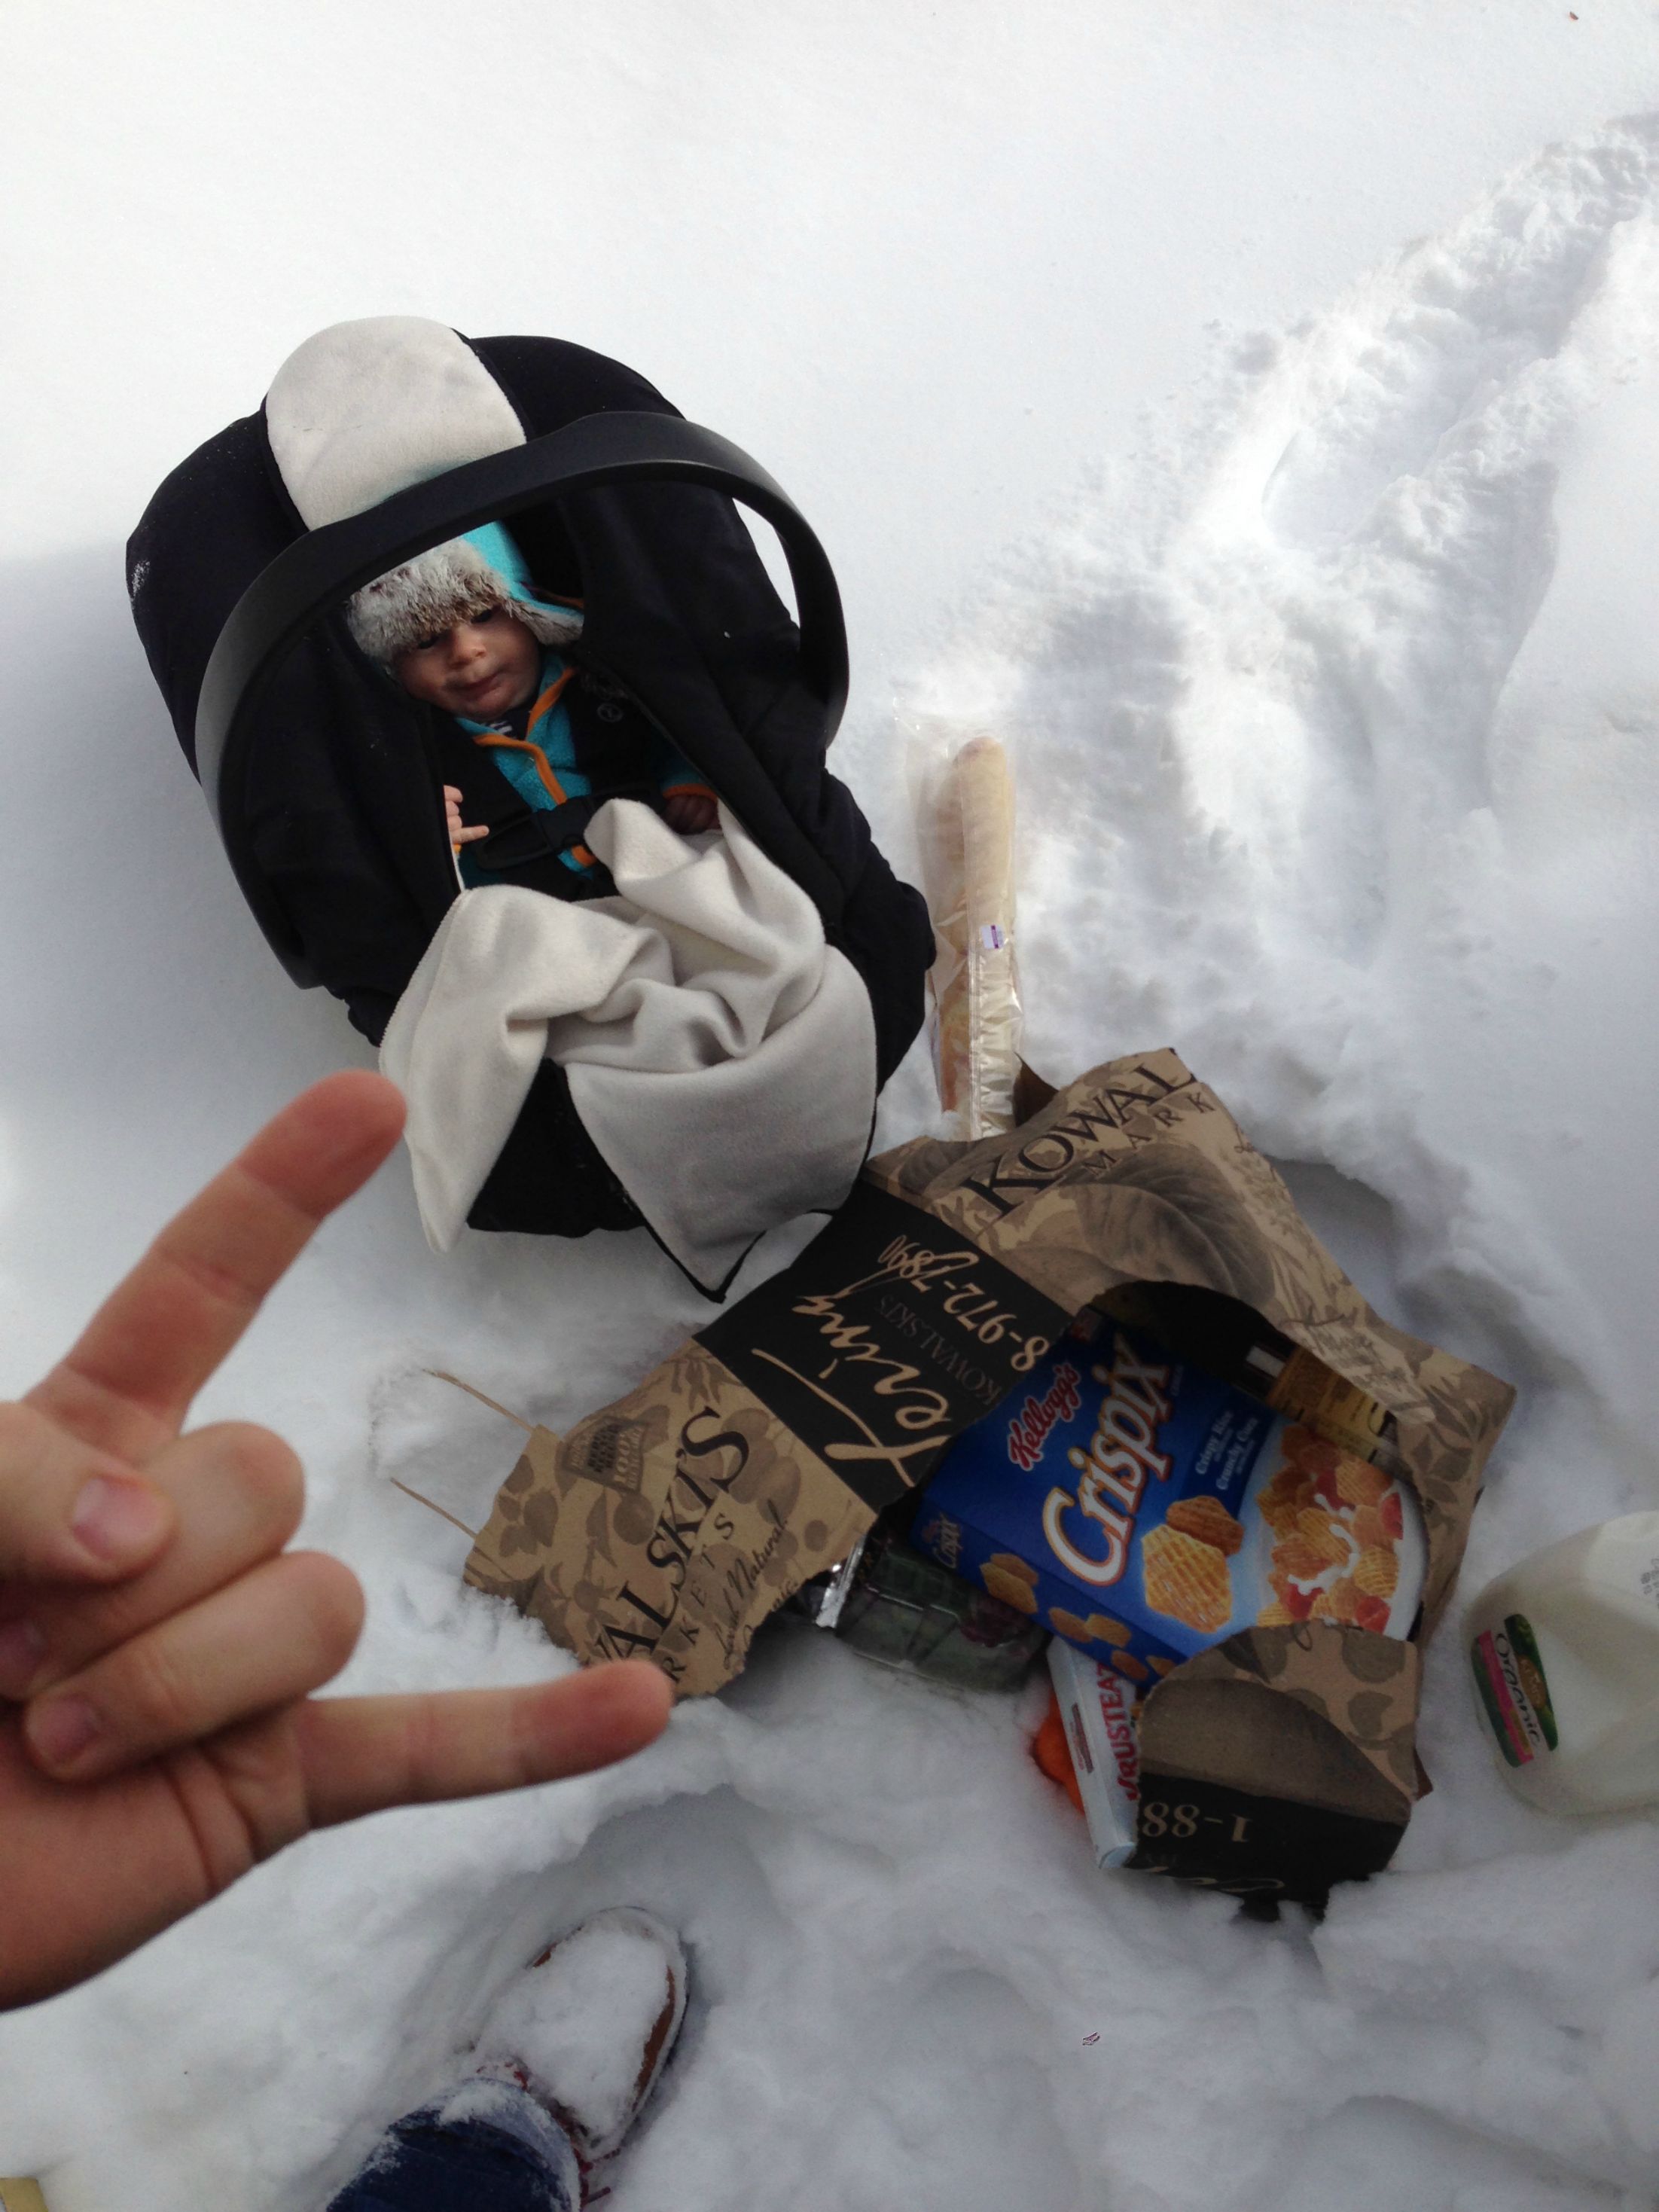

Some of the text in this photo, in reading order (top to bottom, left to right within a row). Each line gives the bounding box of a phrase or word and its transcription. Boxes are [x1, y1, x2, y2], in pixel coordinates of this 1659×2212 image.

[960, 1066, 1197, 1217] KOWAL
[1083, 1094, 1215, 1177] MARK
[1008, 1362, 1081, 1472] Kellogg's
[1042, 1332, 1171, 1586] Crispix
[1496, 1633, 1539, 1747] Organic
[1142, 1802, 1252, 1842] 1-88
